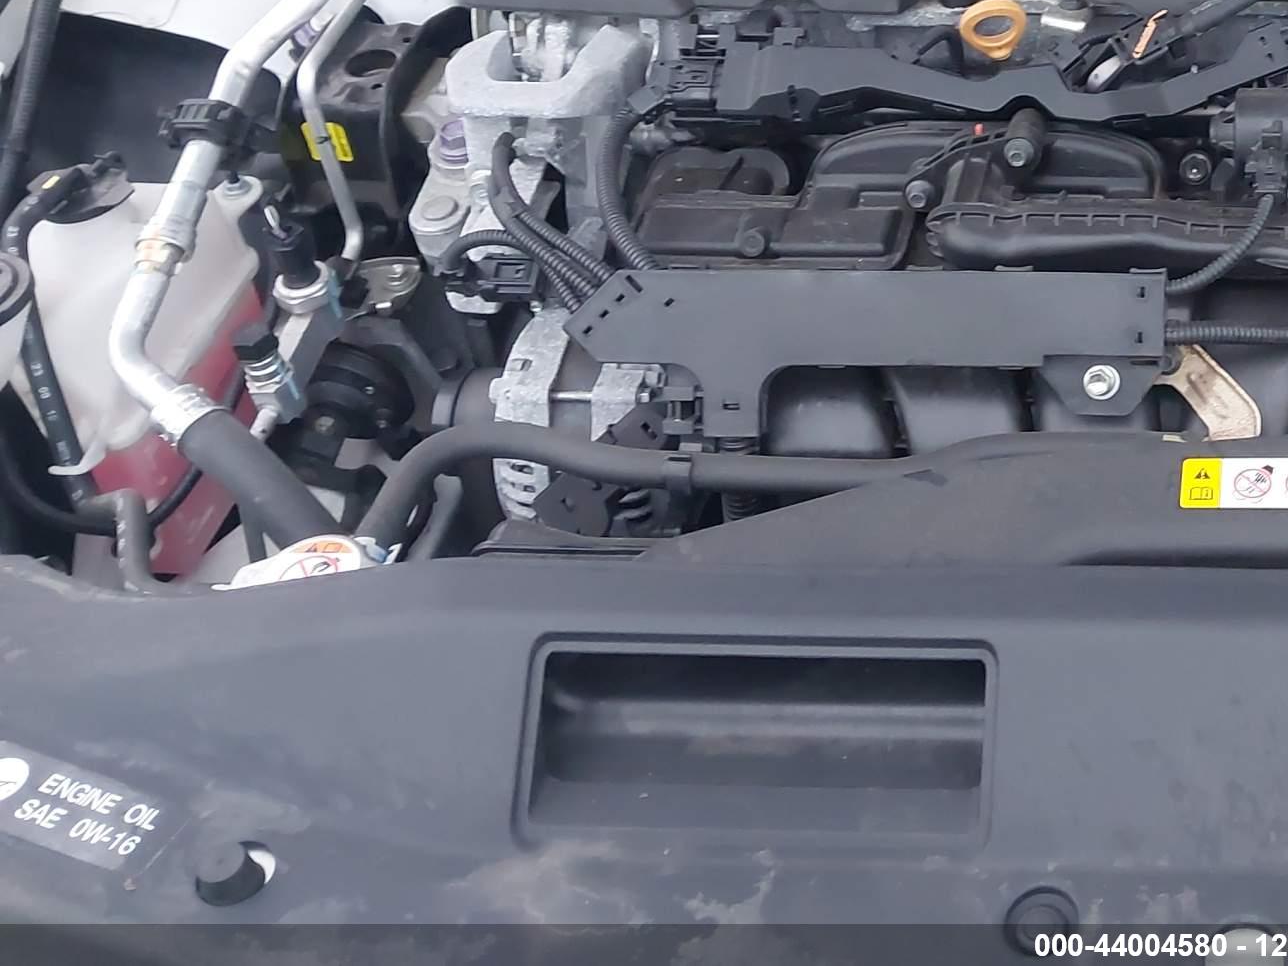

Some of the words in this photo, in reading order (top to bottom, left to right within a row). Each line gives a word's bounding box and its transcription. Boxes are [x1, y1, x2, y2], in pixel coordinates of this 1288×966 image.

[14, 799, 68, 829] SAE
[69, 818, 142, 856] 0W-16
[38, 773, 123, 814] ENGINE
[124, 803, 160, 831] OIL
